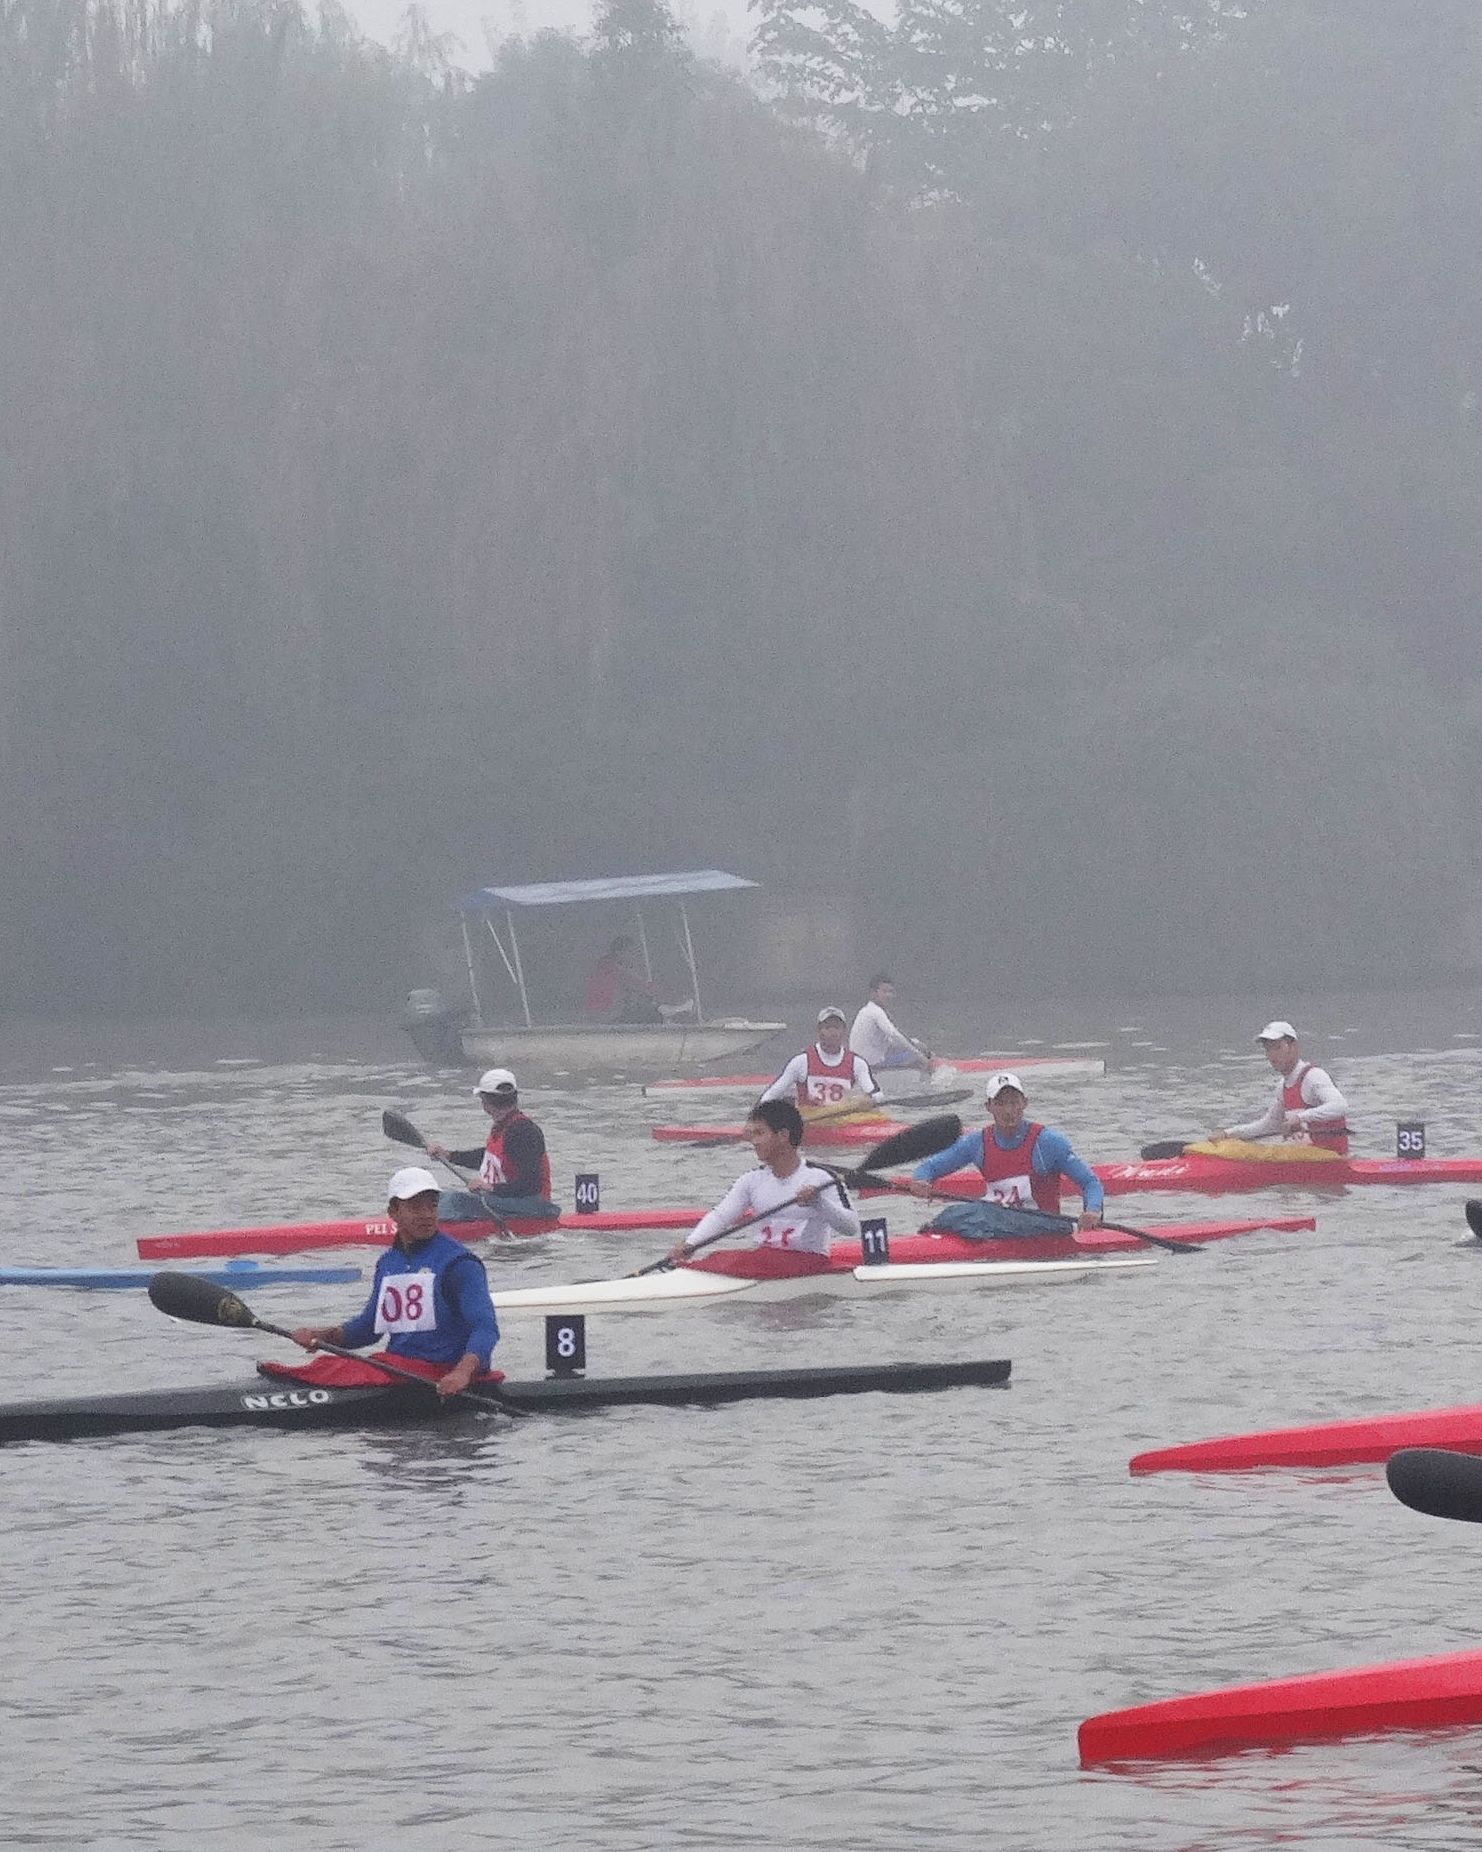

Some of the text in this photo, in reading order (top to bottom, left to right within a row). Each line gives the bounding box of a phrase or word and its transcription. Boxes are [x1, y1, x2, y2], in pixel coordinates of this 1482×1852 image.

[814, 1082, 844, 1106] 38
[1400, 1131, 1424, 1150] 35
[577, 1182, 598, 1203] 40
[864, 1228, 885, 1253] 11
[380, 1283, 424, 1323] 08
[556, 1327, 576, 1358] 8
